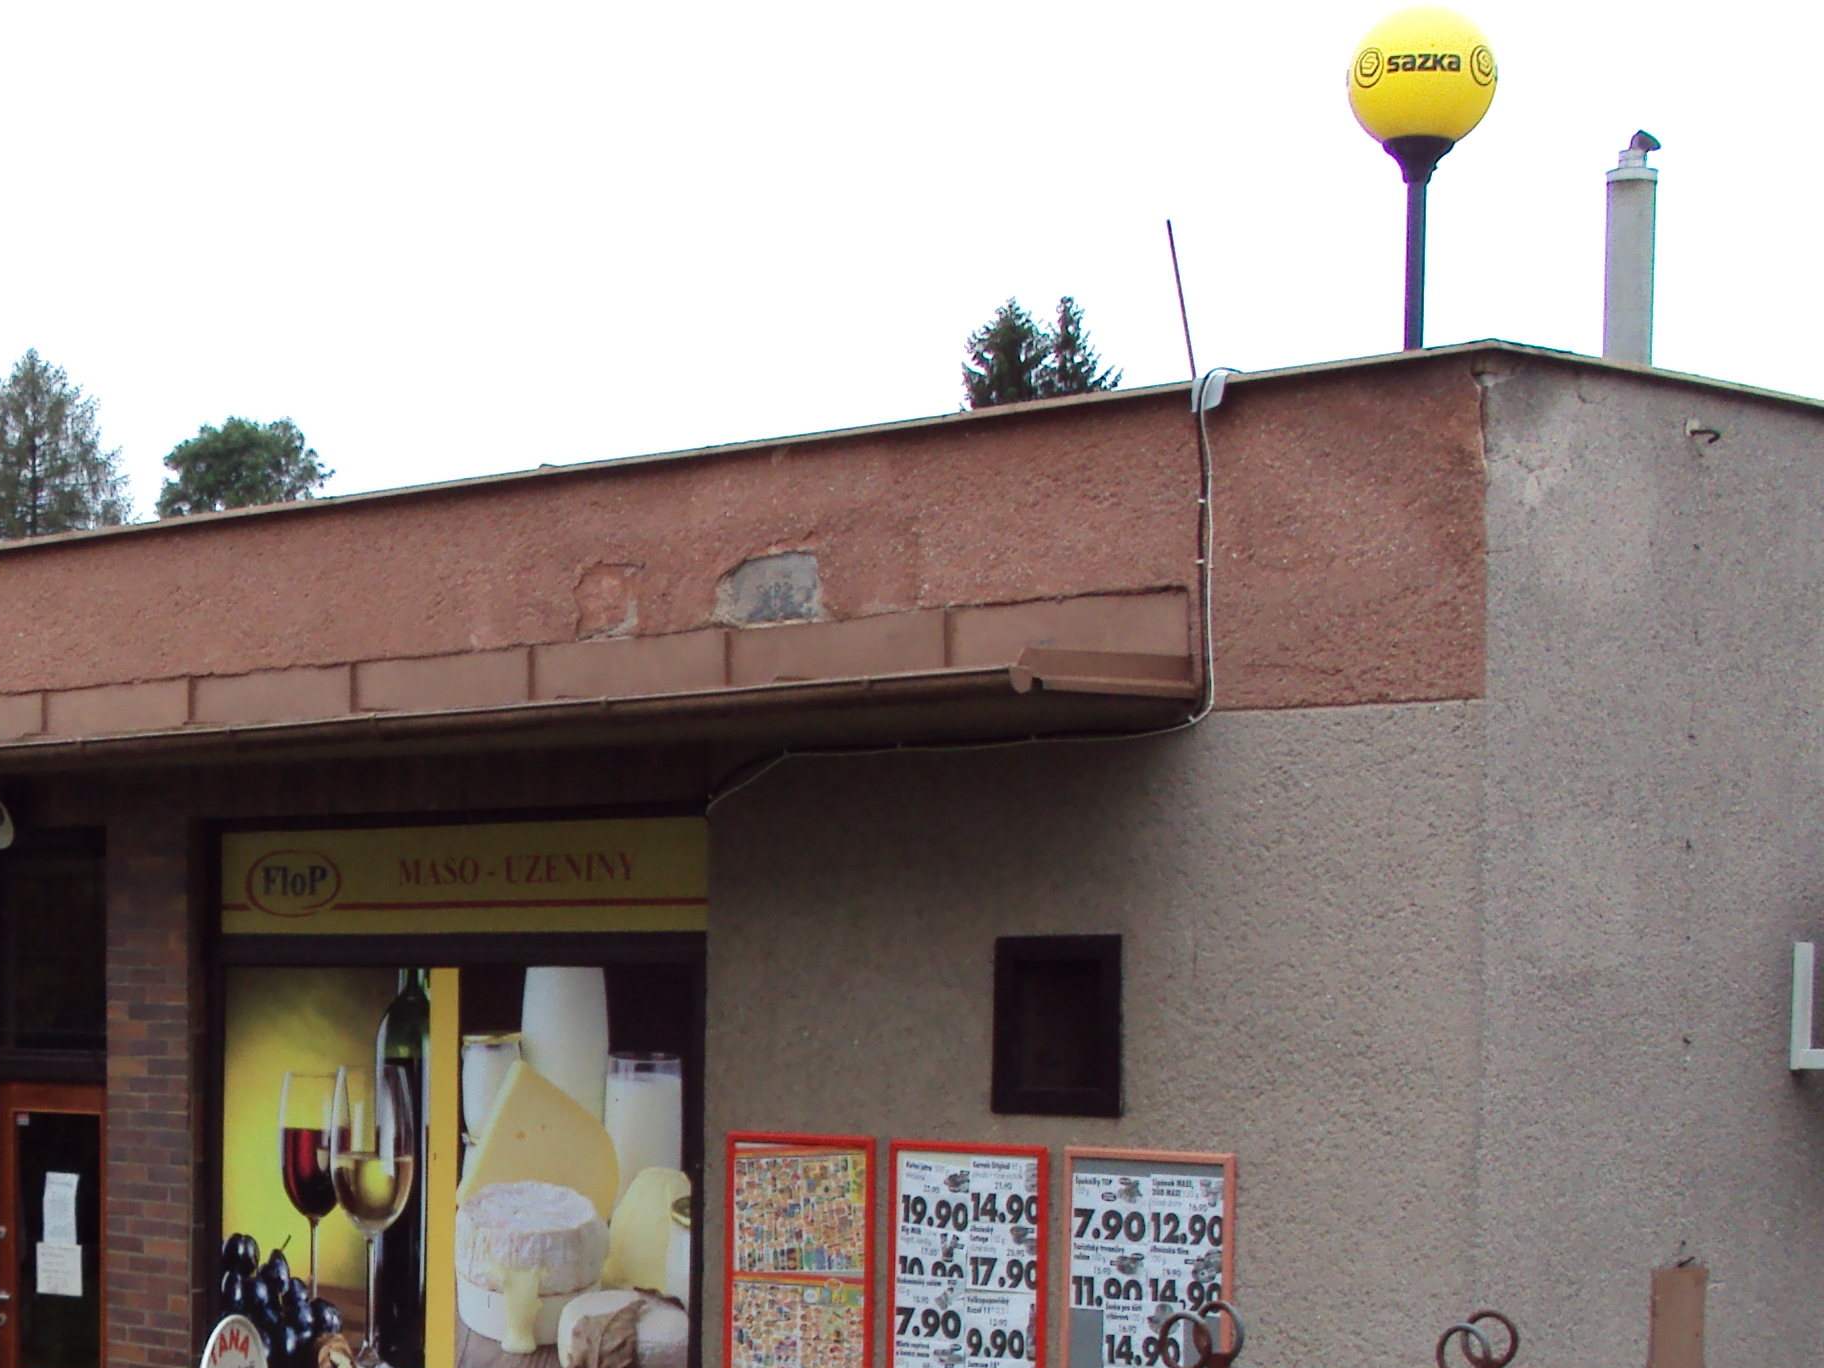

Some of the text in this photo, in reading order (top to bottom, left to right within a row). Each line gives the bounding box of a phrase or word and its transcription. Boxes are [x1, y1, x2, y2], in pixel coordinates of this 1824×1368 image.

[398, 857, 480, 886] MASO
[505, 853, 637, 884] UZENINY
[902, 1194, 968, 1231] 19.90
[971, 1192, 1038, 1225] 14.90
[1074, 1208, 1146, 1242] 7.90
[1151, 1212, 1223, 1247] 12.90
[970, 1257, 1037, 1290] 17.90
[896, 1306, 961, 1339] 7.90
[967, 1328, 1024, 1359] 9.90
[1105, 1334, 1181, 1367] 14.90
